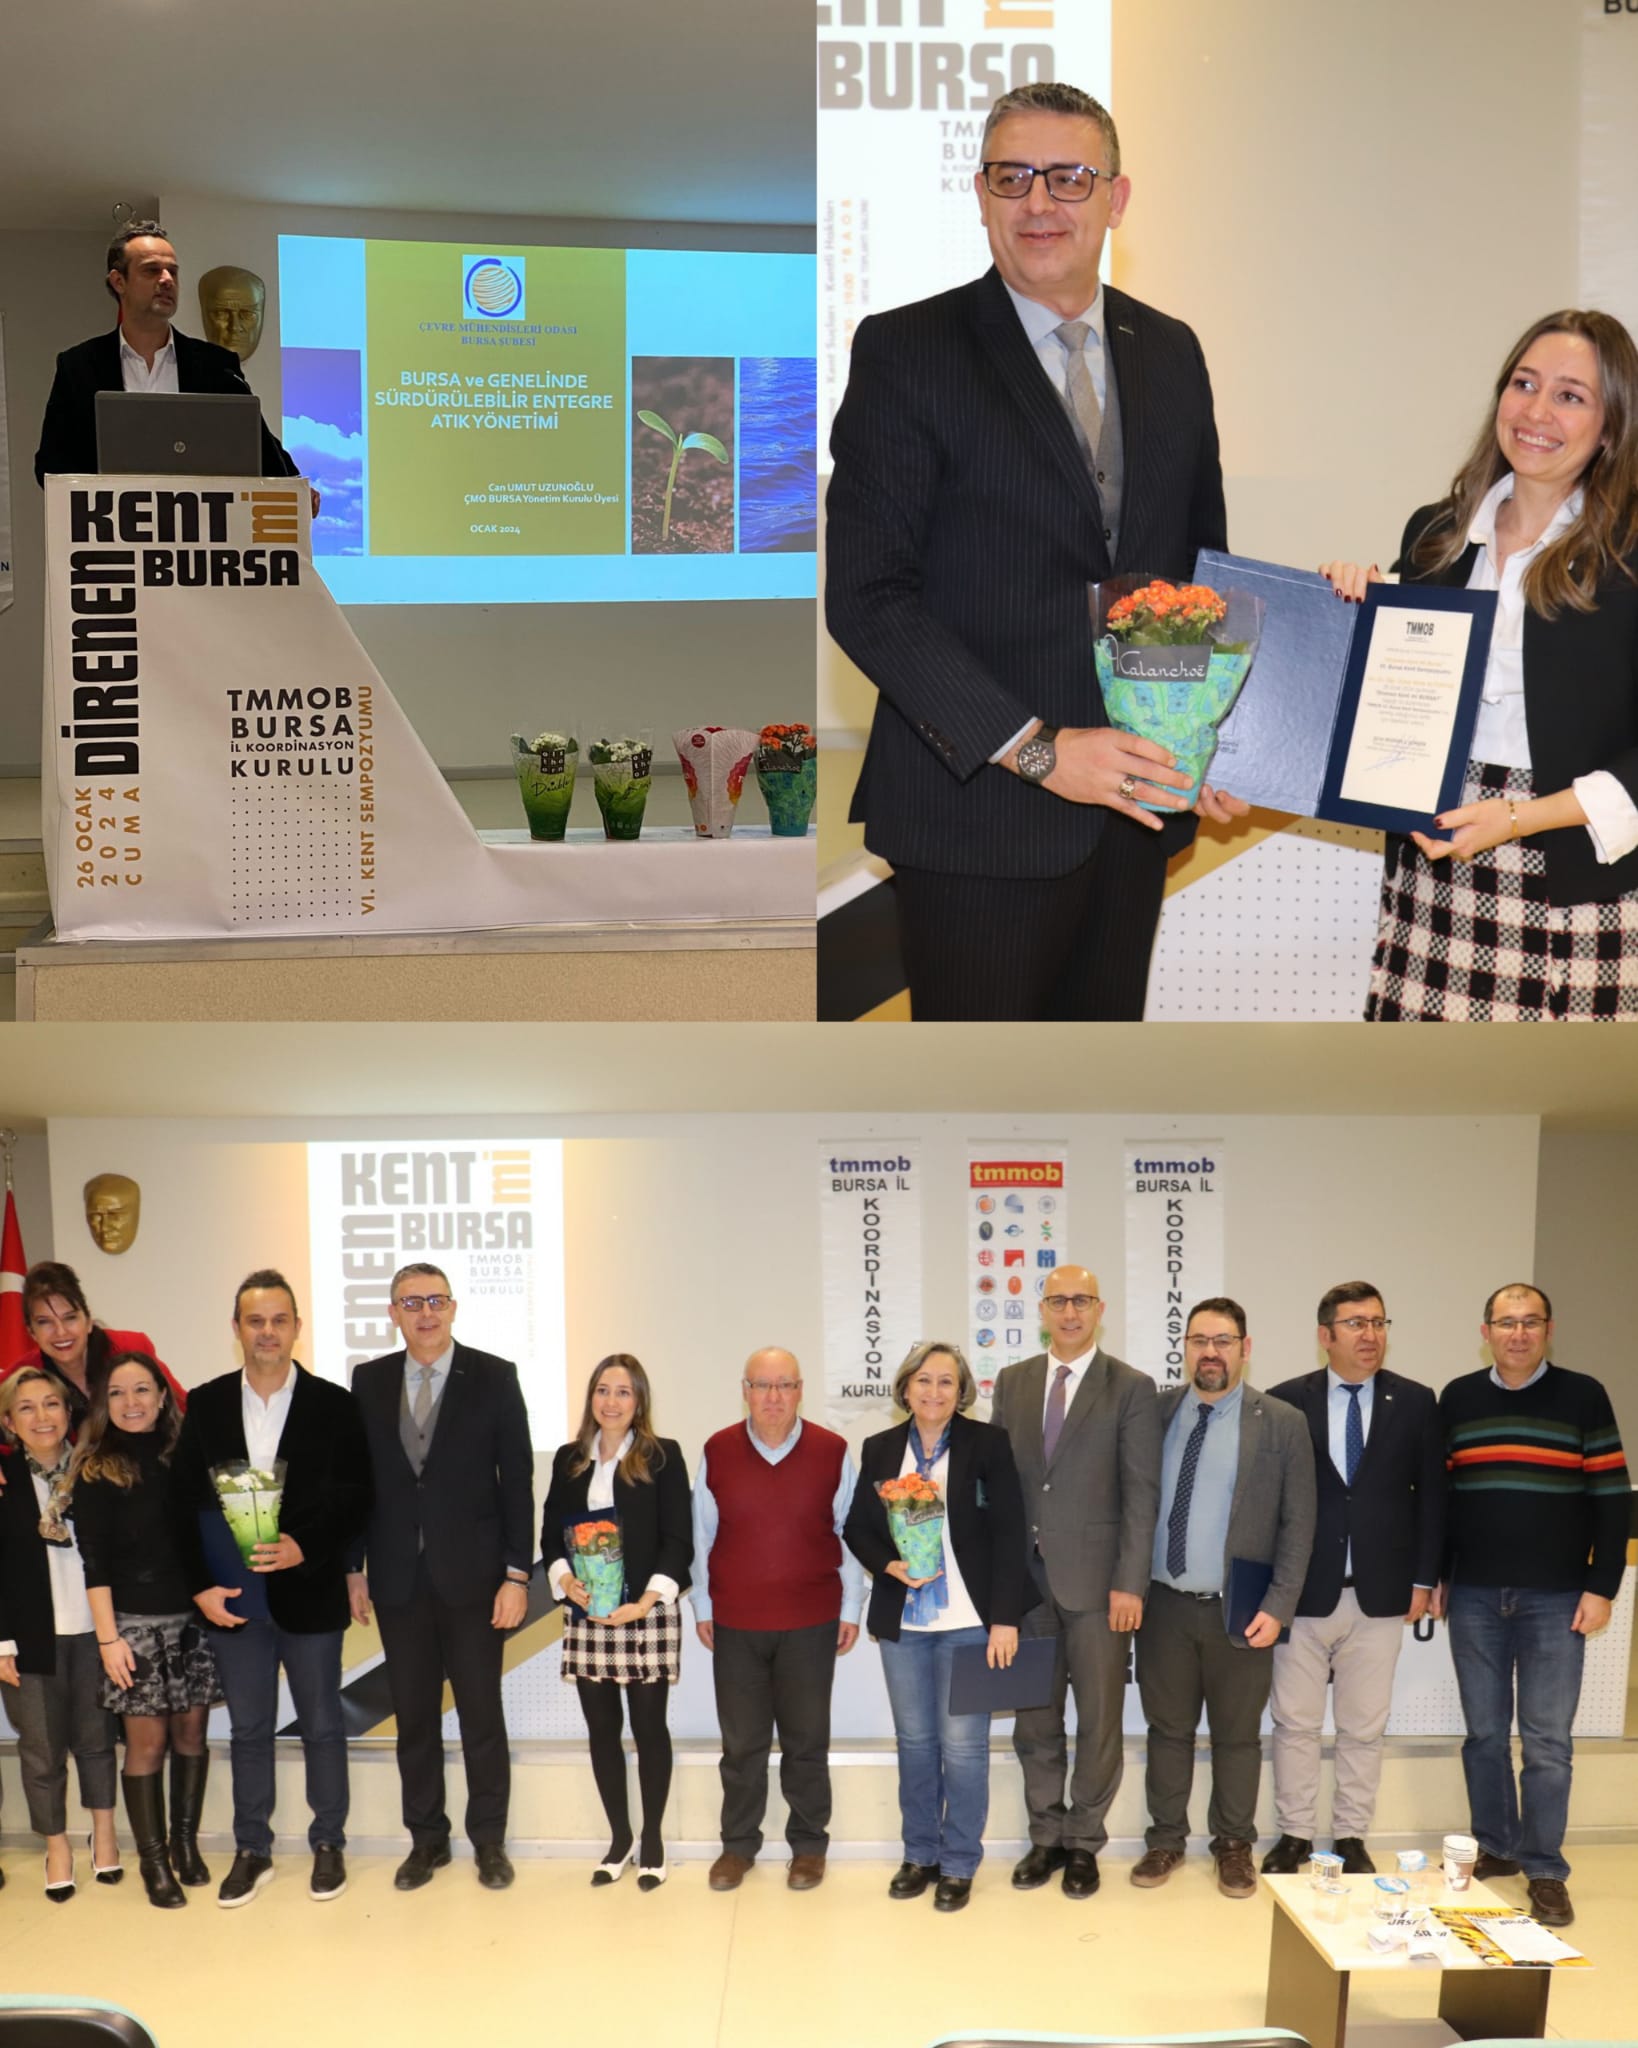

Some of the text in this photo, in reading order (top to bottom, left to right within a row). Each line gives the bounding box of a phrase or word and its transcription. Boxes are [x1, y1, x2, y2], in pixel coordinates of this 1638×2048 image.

[461, 335, 496, 346] BURSA
[401, 370, 588, 388] BURSA ve GENELİNDE
[374, 388, 613, 409] SÜRDÜRÜLEBİLİR ENTEGRE
[431, 411, 558, 430] ATIK YÖNETİMİ
[488, 480, 594, 492] Can UMUT UZUNOĞLU
[464, 493, 619, 505] ÇMO BURSA Yönetim Kurulu Üyesi
[70, 490, 234, 543] KENT
[470, 524, 520, 535] OCAK 2024
[143, 550, 300, 586] BURSA
[1406, 621, 1435, 636] TMMOB
[61, 550, 139, 777] DİRENEN
[227, 687, 352, 711] TMMOB
[231, 714, 354, 739] BURSA
[230, 739, 354, 753] İL KOORDİNASYON
[231, 756, 354, 777] KURULU
[358, 685, 376, 916] VI. KENT SEMPOZYUMU
[75, 787, 94, 889] 26 OCAK
[98, 786, 118, 887] 2024
[123, 787, 142, 886] CUMA
[830, 1156, 912, 1173] tmmob
[972, 1163, 1061, 1183] tmmob
[1134, 1157, 1215, 1174] tmmob
[341, 1151, 477, 1206] KENT
[832, 1176, 910, 1192] BURSA İL
[1136, 1177, 1214, 1193] BURSA İL
[401, 1211, 533, 1251] BURSA
[469, 1254, 523, 1265] TMMOB
[470, 1266, 523, 1277] BURSA
[469, 1285, 525, 1295] KURULU
[863, 1197, 882, 1380] KOORDİNASYON
[1165, 1199, 1183, 1381] KOORDİNASYON
[842, 1385, 894, 1398] KURUL
